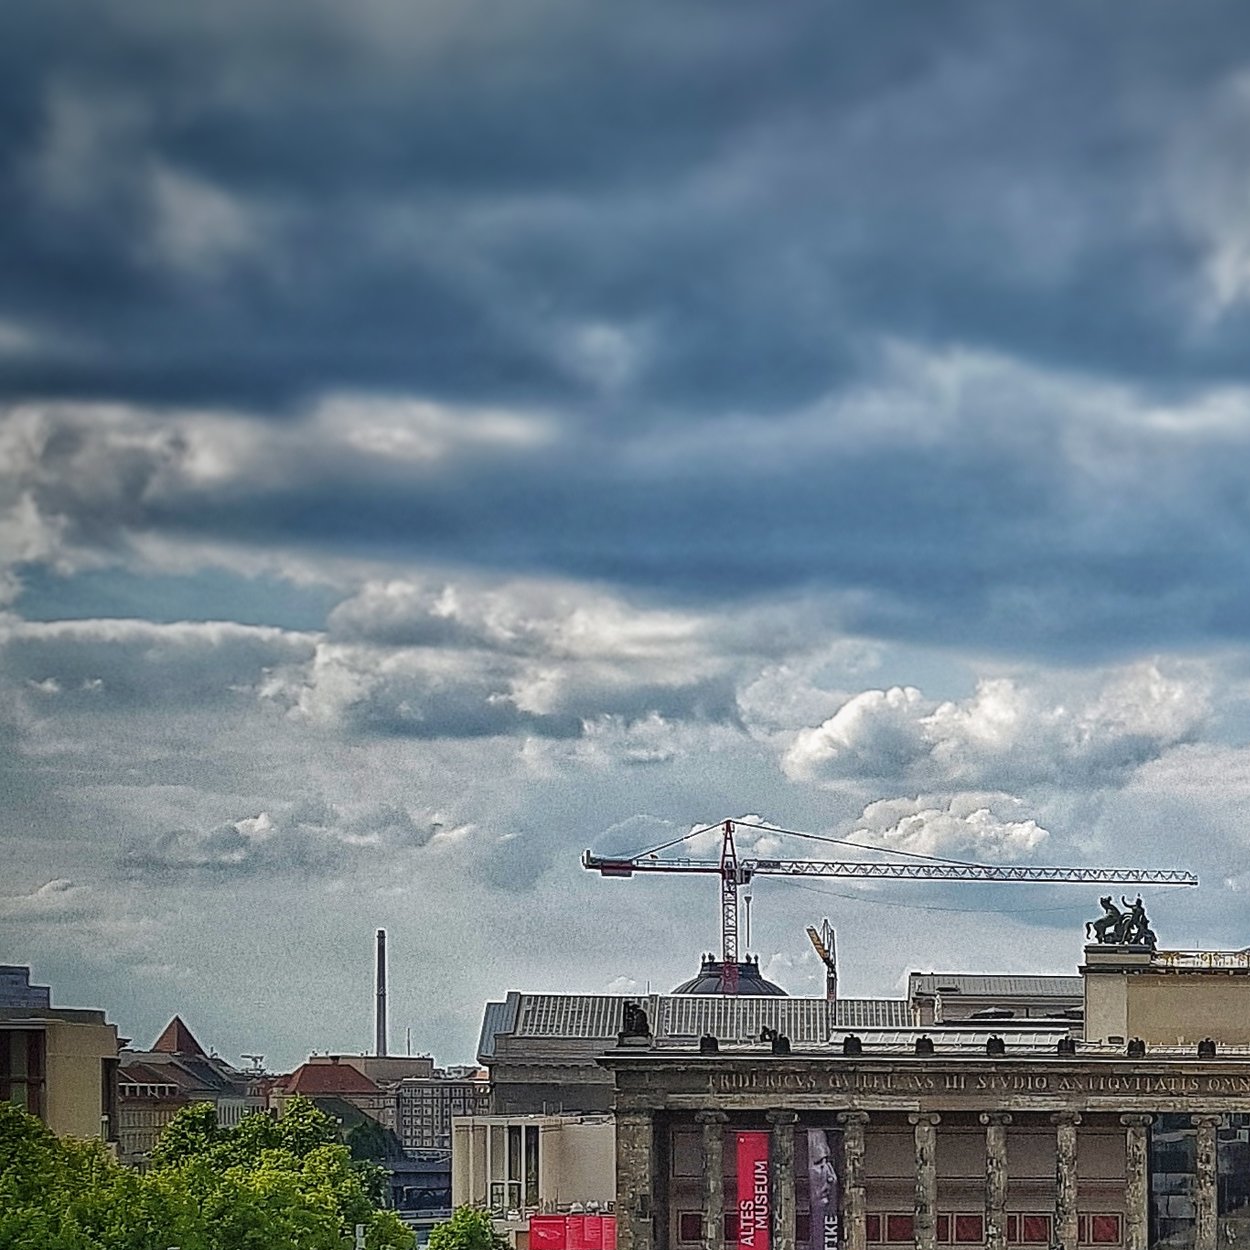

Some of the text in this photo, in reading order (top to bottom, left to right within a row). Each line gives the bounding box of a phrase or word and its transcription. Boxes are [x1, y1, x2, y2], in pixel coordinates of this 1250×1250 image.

[708, 1074, 816, 1088] FRIDERICVS
[945, 1075, 966, 1089] III
[976, 1075, 1048, 1090] STVDIO
[1059, 1075, 1199, 1091] ANTIQVITATIS
[754, 1160, 769, 1229] MUSEUM
[740, 1200, 755, 1247] ALTES
